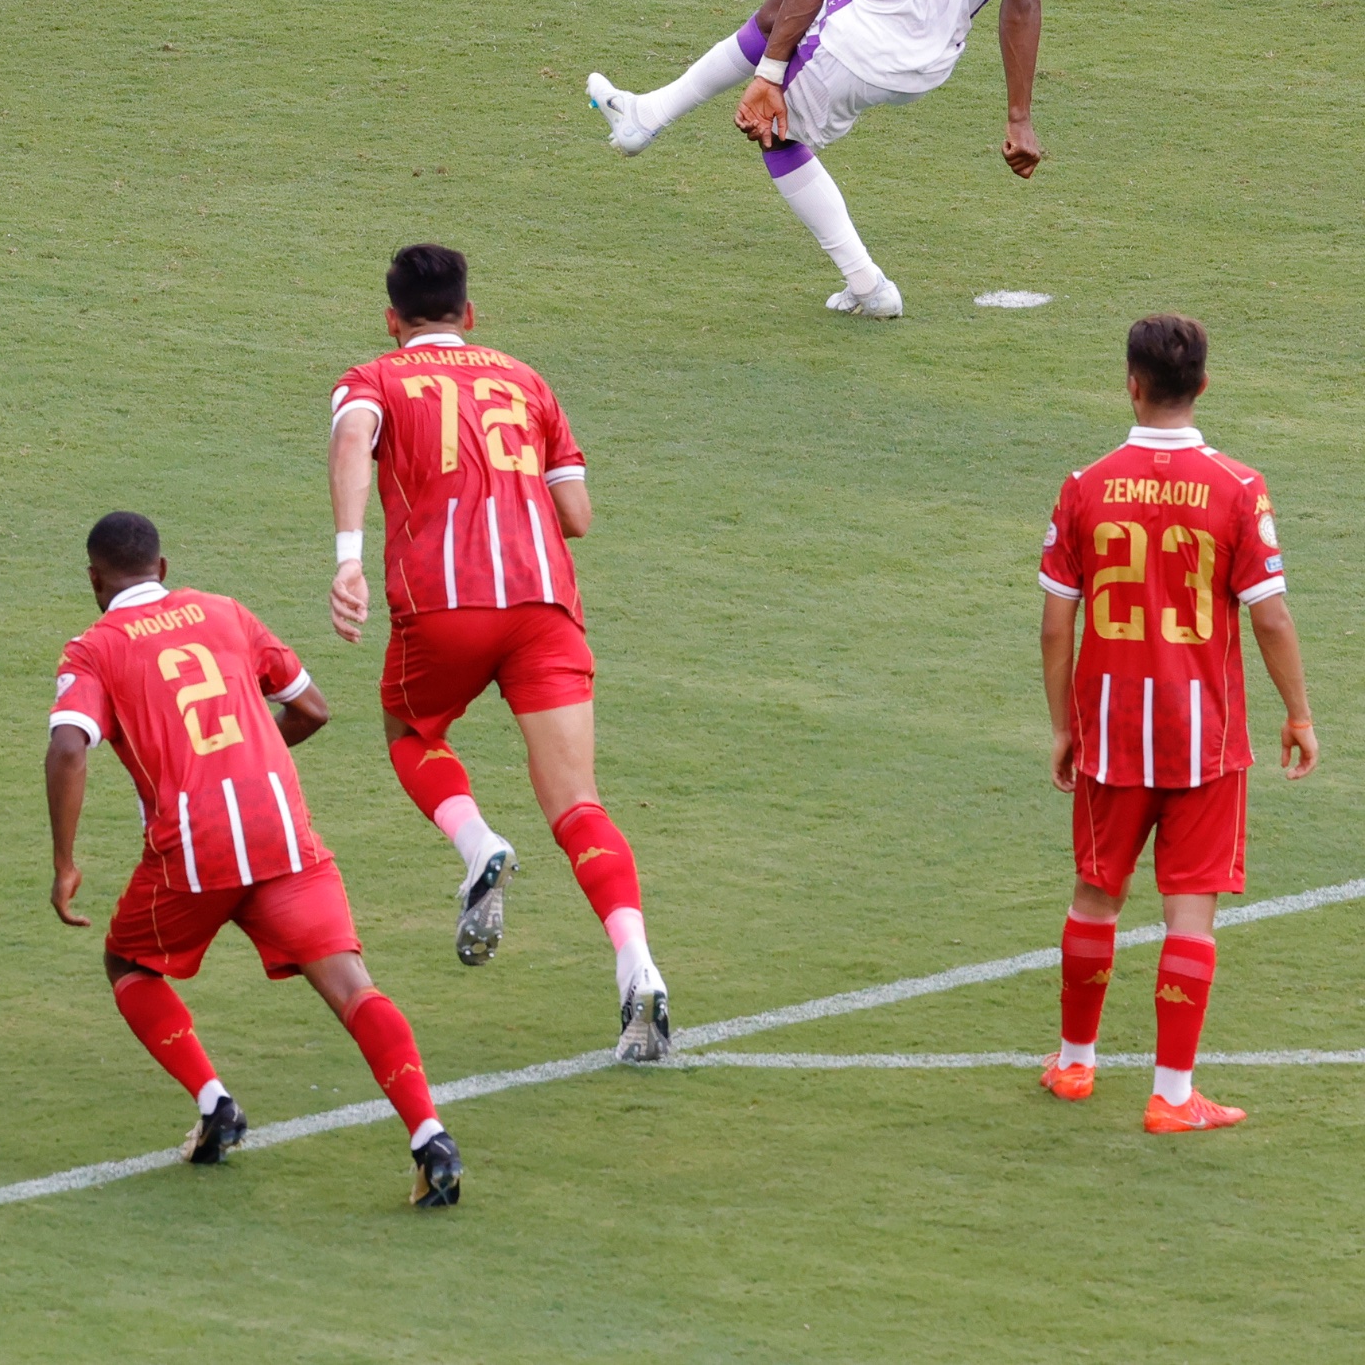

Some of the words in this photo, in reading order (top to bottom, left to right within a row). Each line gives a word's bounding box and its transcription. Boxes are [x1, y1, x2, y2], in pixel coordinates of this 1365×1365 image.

[390, 350, 514, 370] GUILHERME
[400, 374, 539, 477] 72
[1102, 477, 1211, 510] ZEMRAOUI
[1092, 520, 1216, 645] 23
[123, 603, 207, 641] MOUFID
[157, 642, 245, 757] 2
